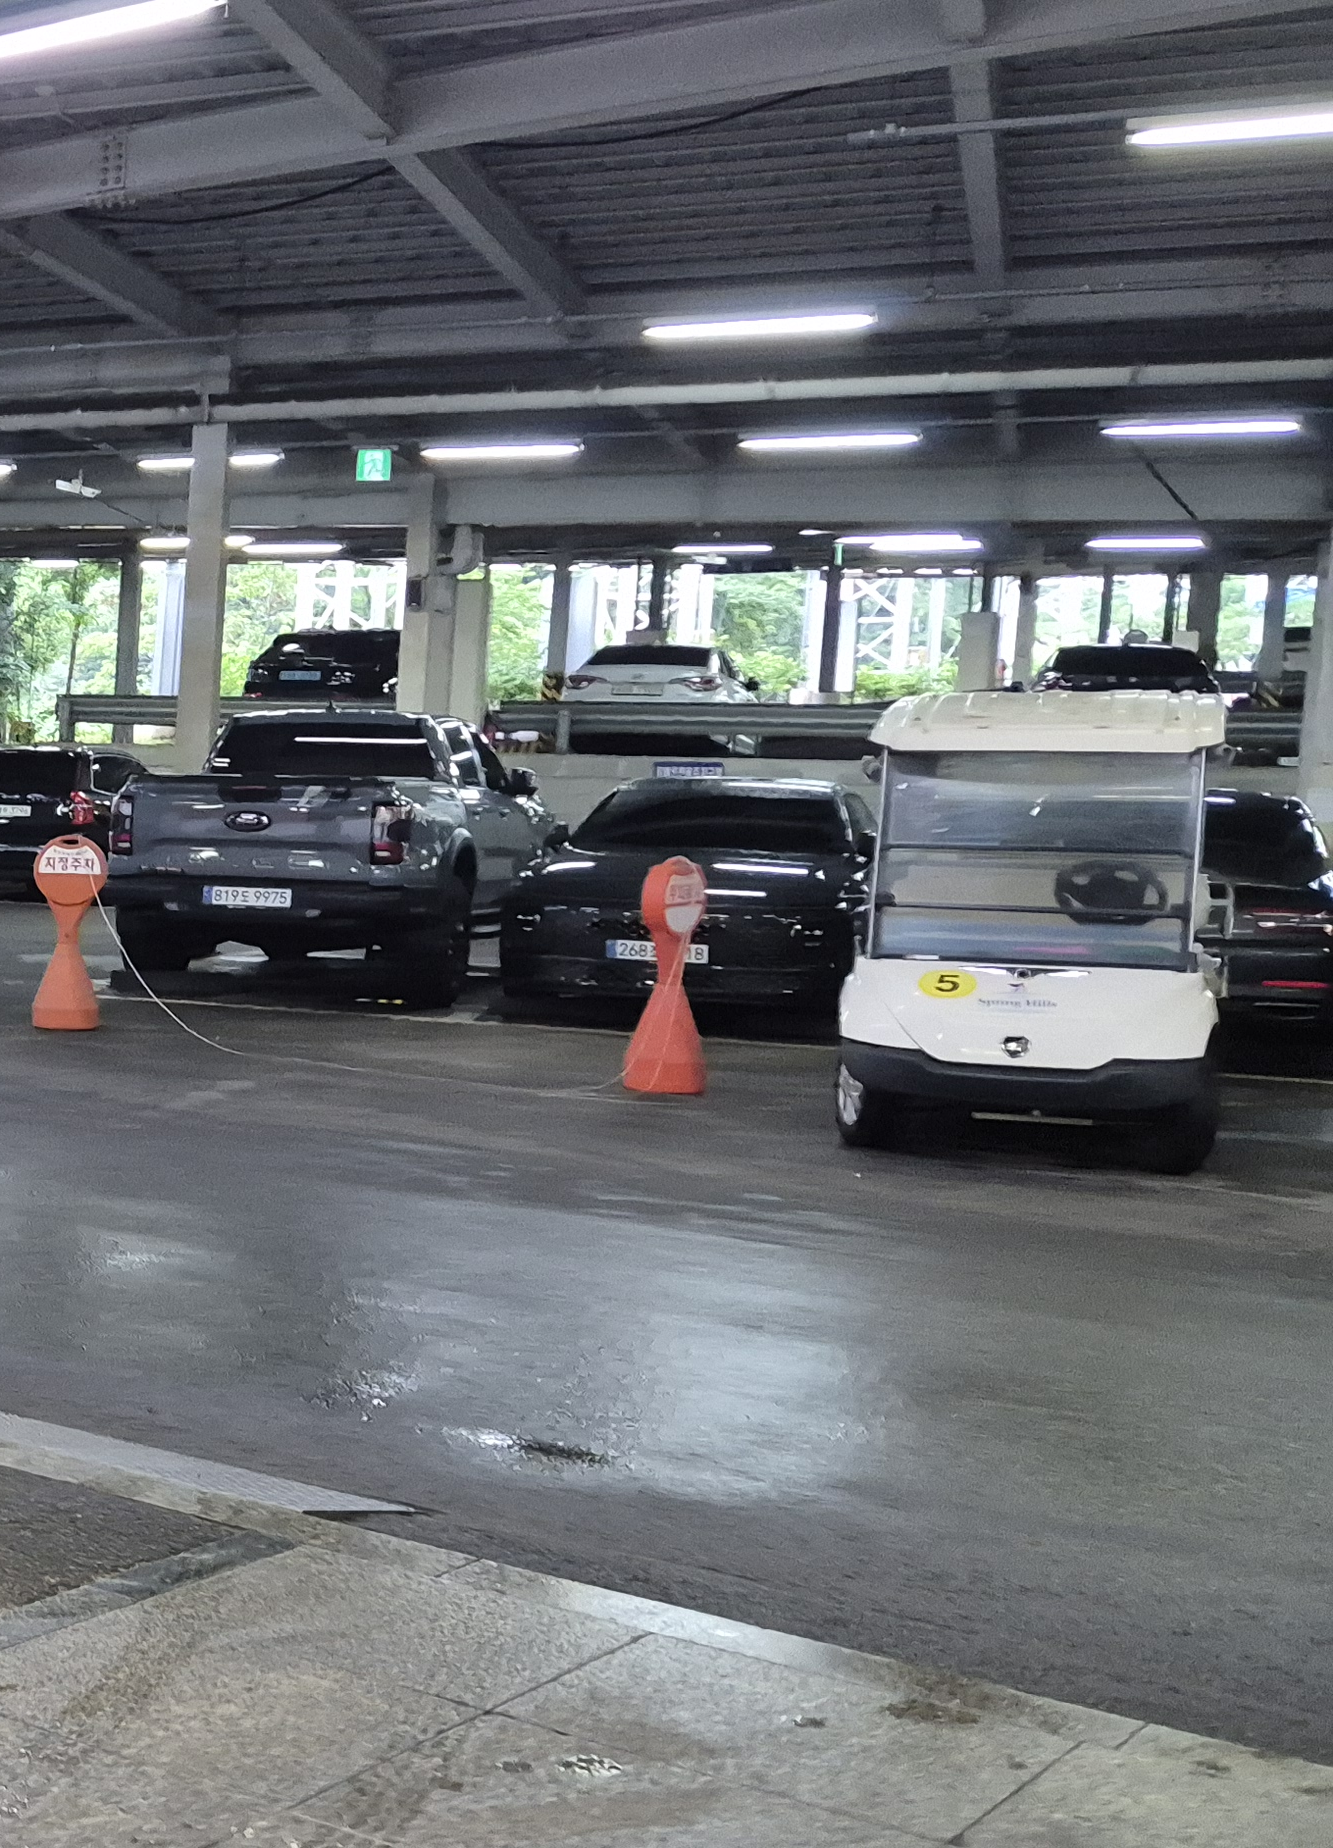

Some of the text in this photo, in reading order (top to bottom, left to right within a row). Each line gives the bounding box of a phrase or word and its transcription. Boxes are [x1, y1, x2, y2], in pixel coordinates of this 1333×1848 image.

[44, 856, 95, 872] 지정주차
[214, 889, 287, 904] 819도 9975
[935, 974, 960, 993] 5
